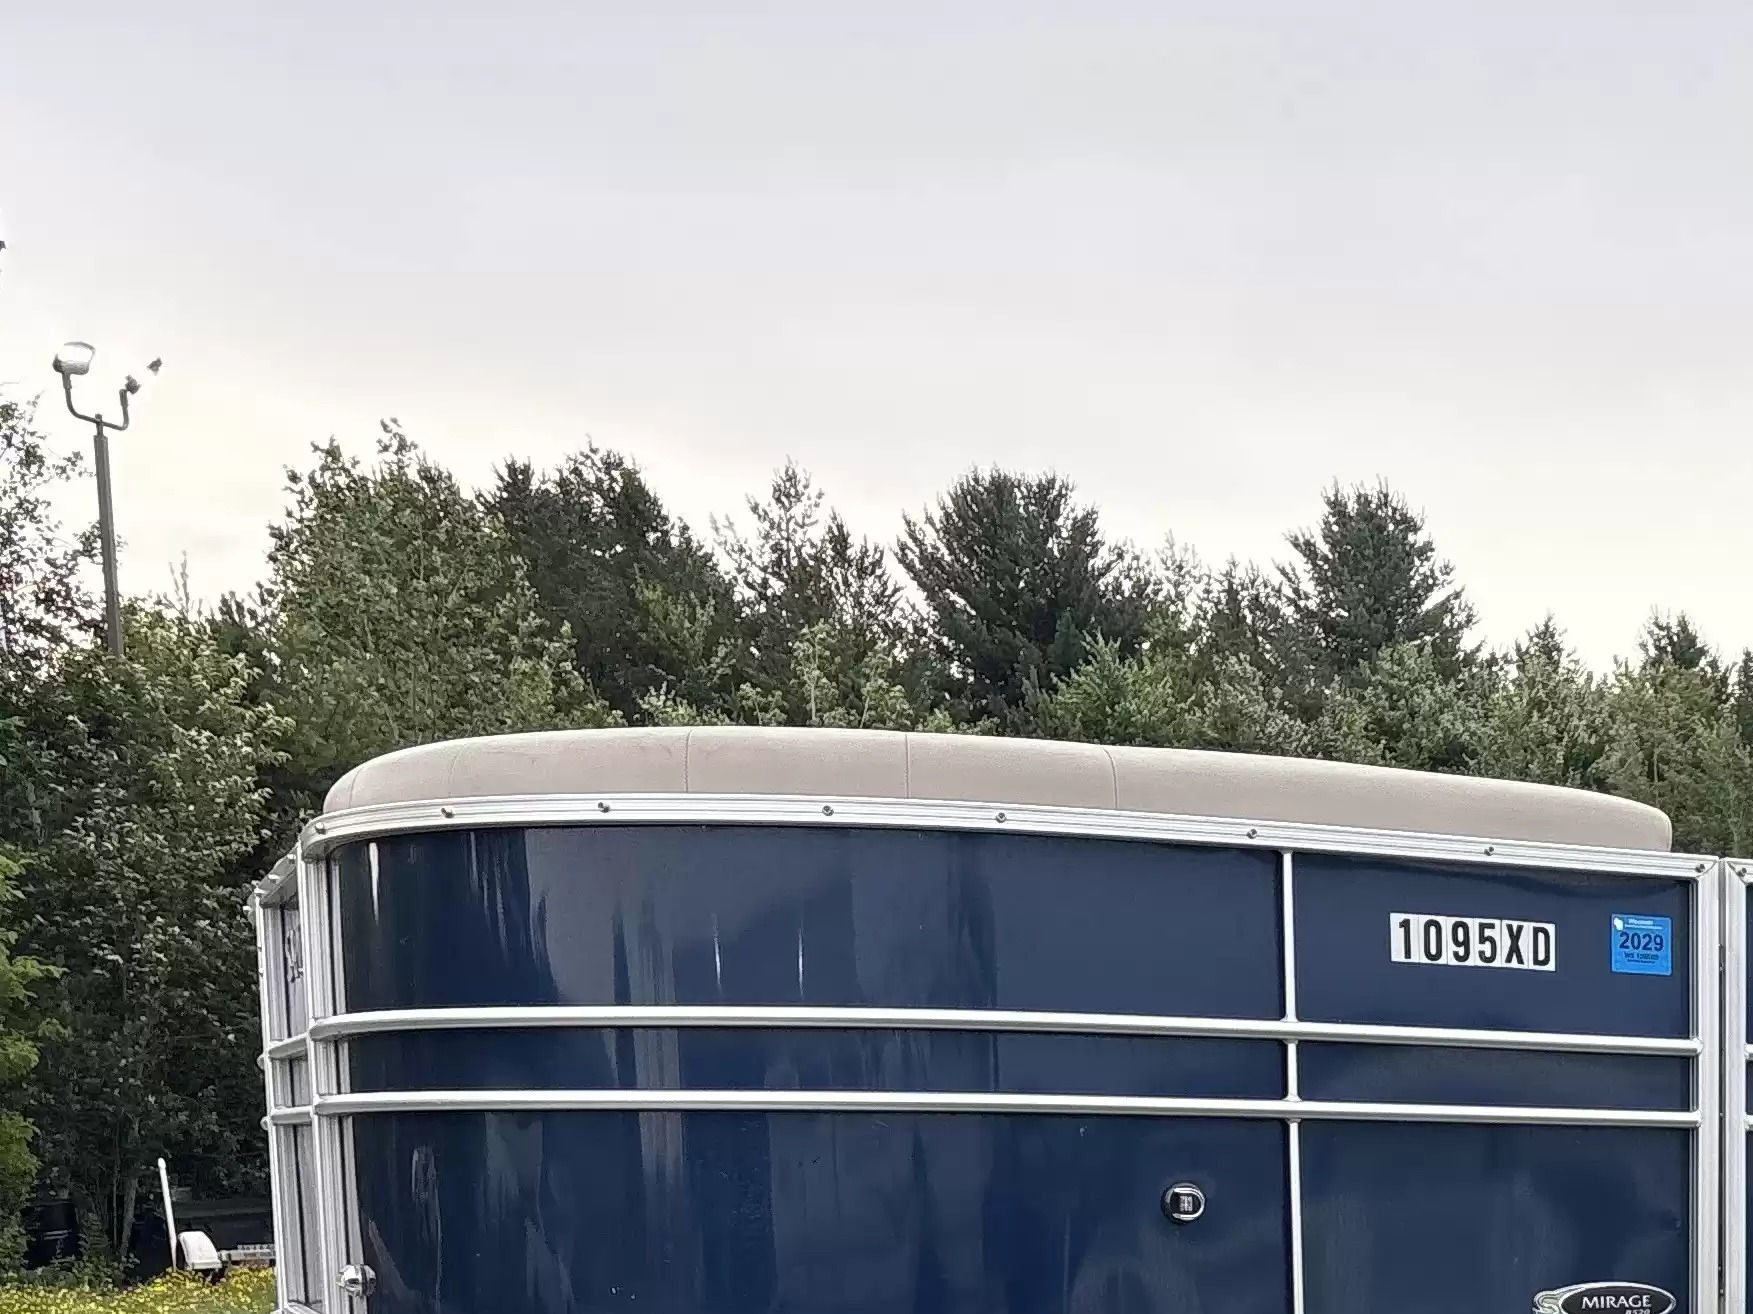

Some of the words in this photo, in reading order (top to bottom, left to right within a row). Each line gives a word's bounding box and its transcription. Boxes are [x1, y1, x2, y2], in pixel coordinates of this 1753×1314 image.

[1398, 919, 1552, 967] 1095XD
[1619, 931, 1664, 952] 2029
[1581, 1294, 1652, 1310] MIRAGE
